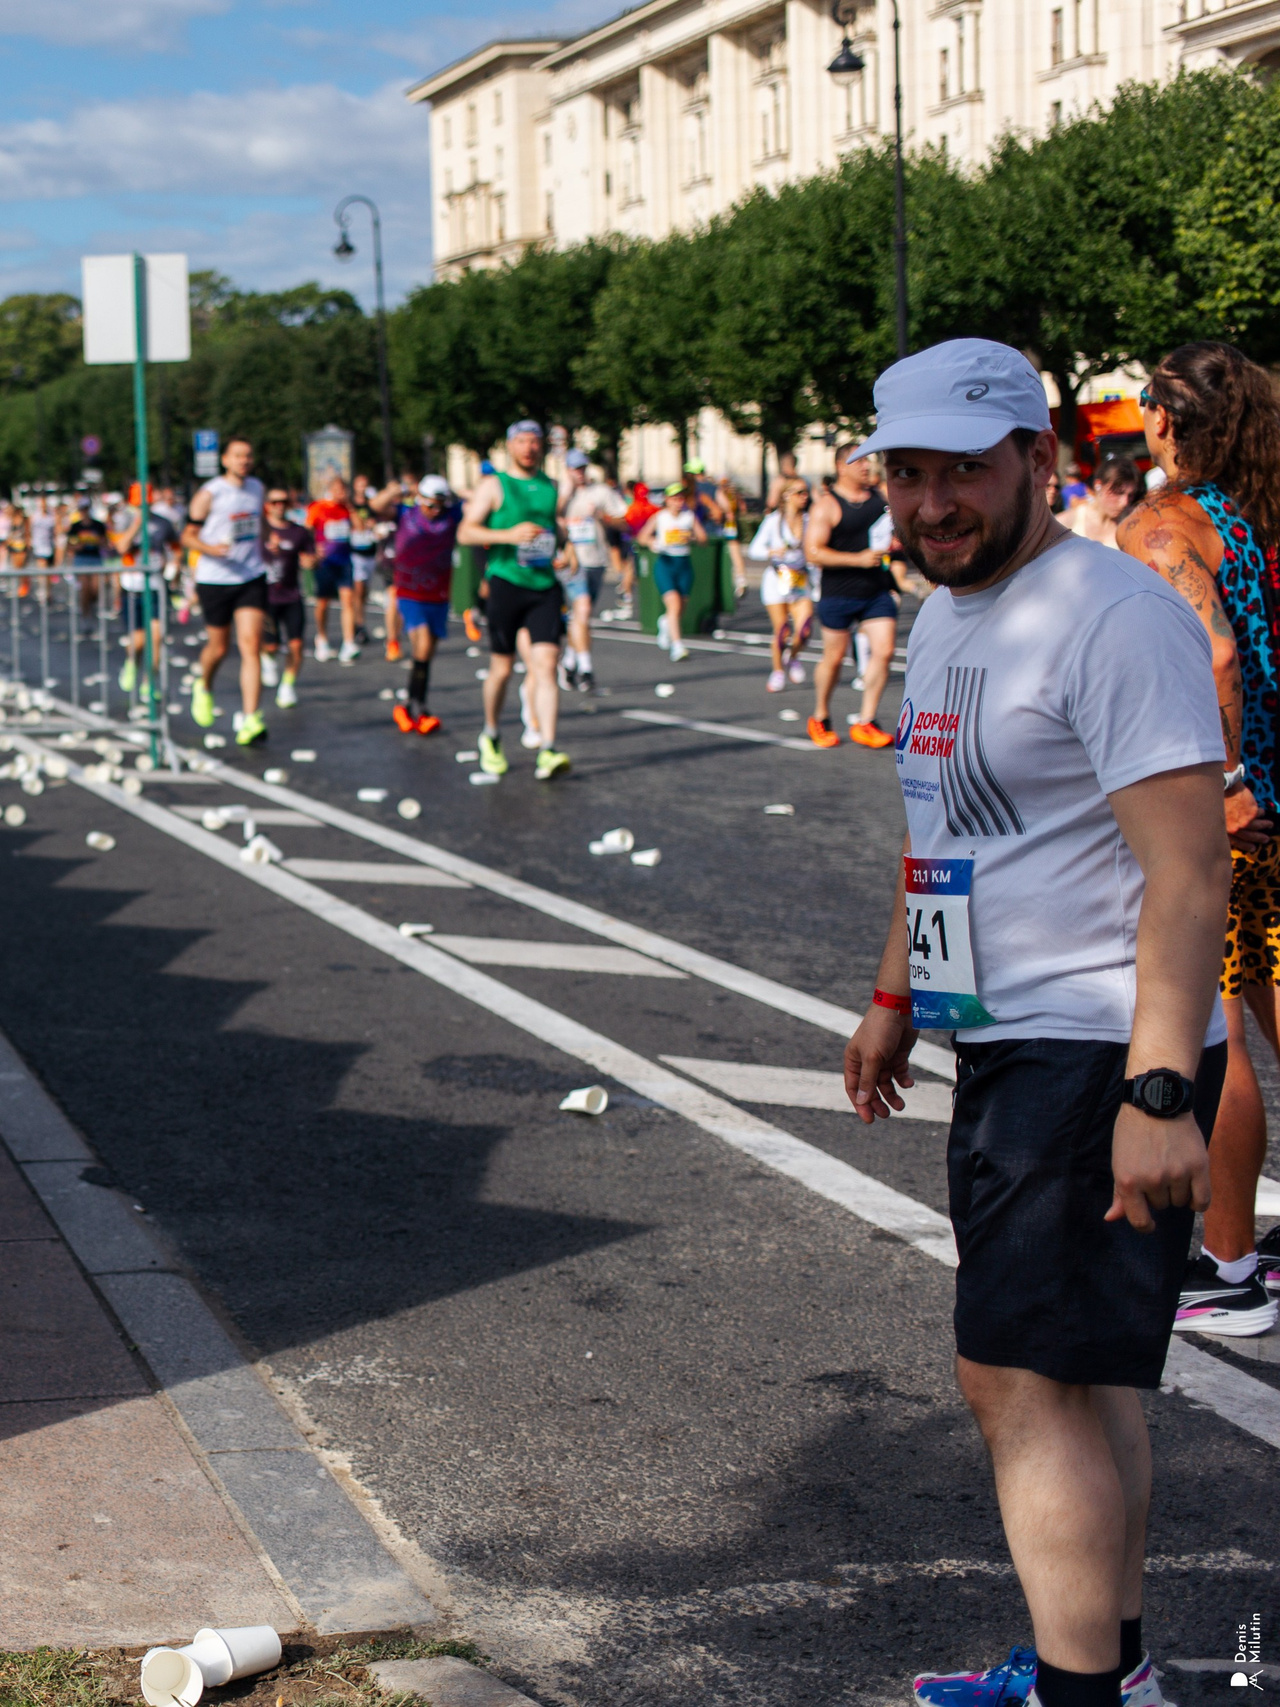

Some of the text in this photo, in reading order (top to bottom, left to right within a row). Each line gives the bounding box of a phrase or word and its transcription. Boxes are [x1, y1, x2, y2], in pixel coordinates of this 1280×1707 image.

[912, 711, 960, 733] ДОРОГА
[909, 734, 955, 758] ЖИЗНИ
[896, 754, 904, 765] 20
[912, 869, 929, 884] 21,1
